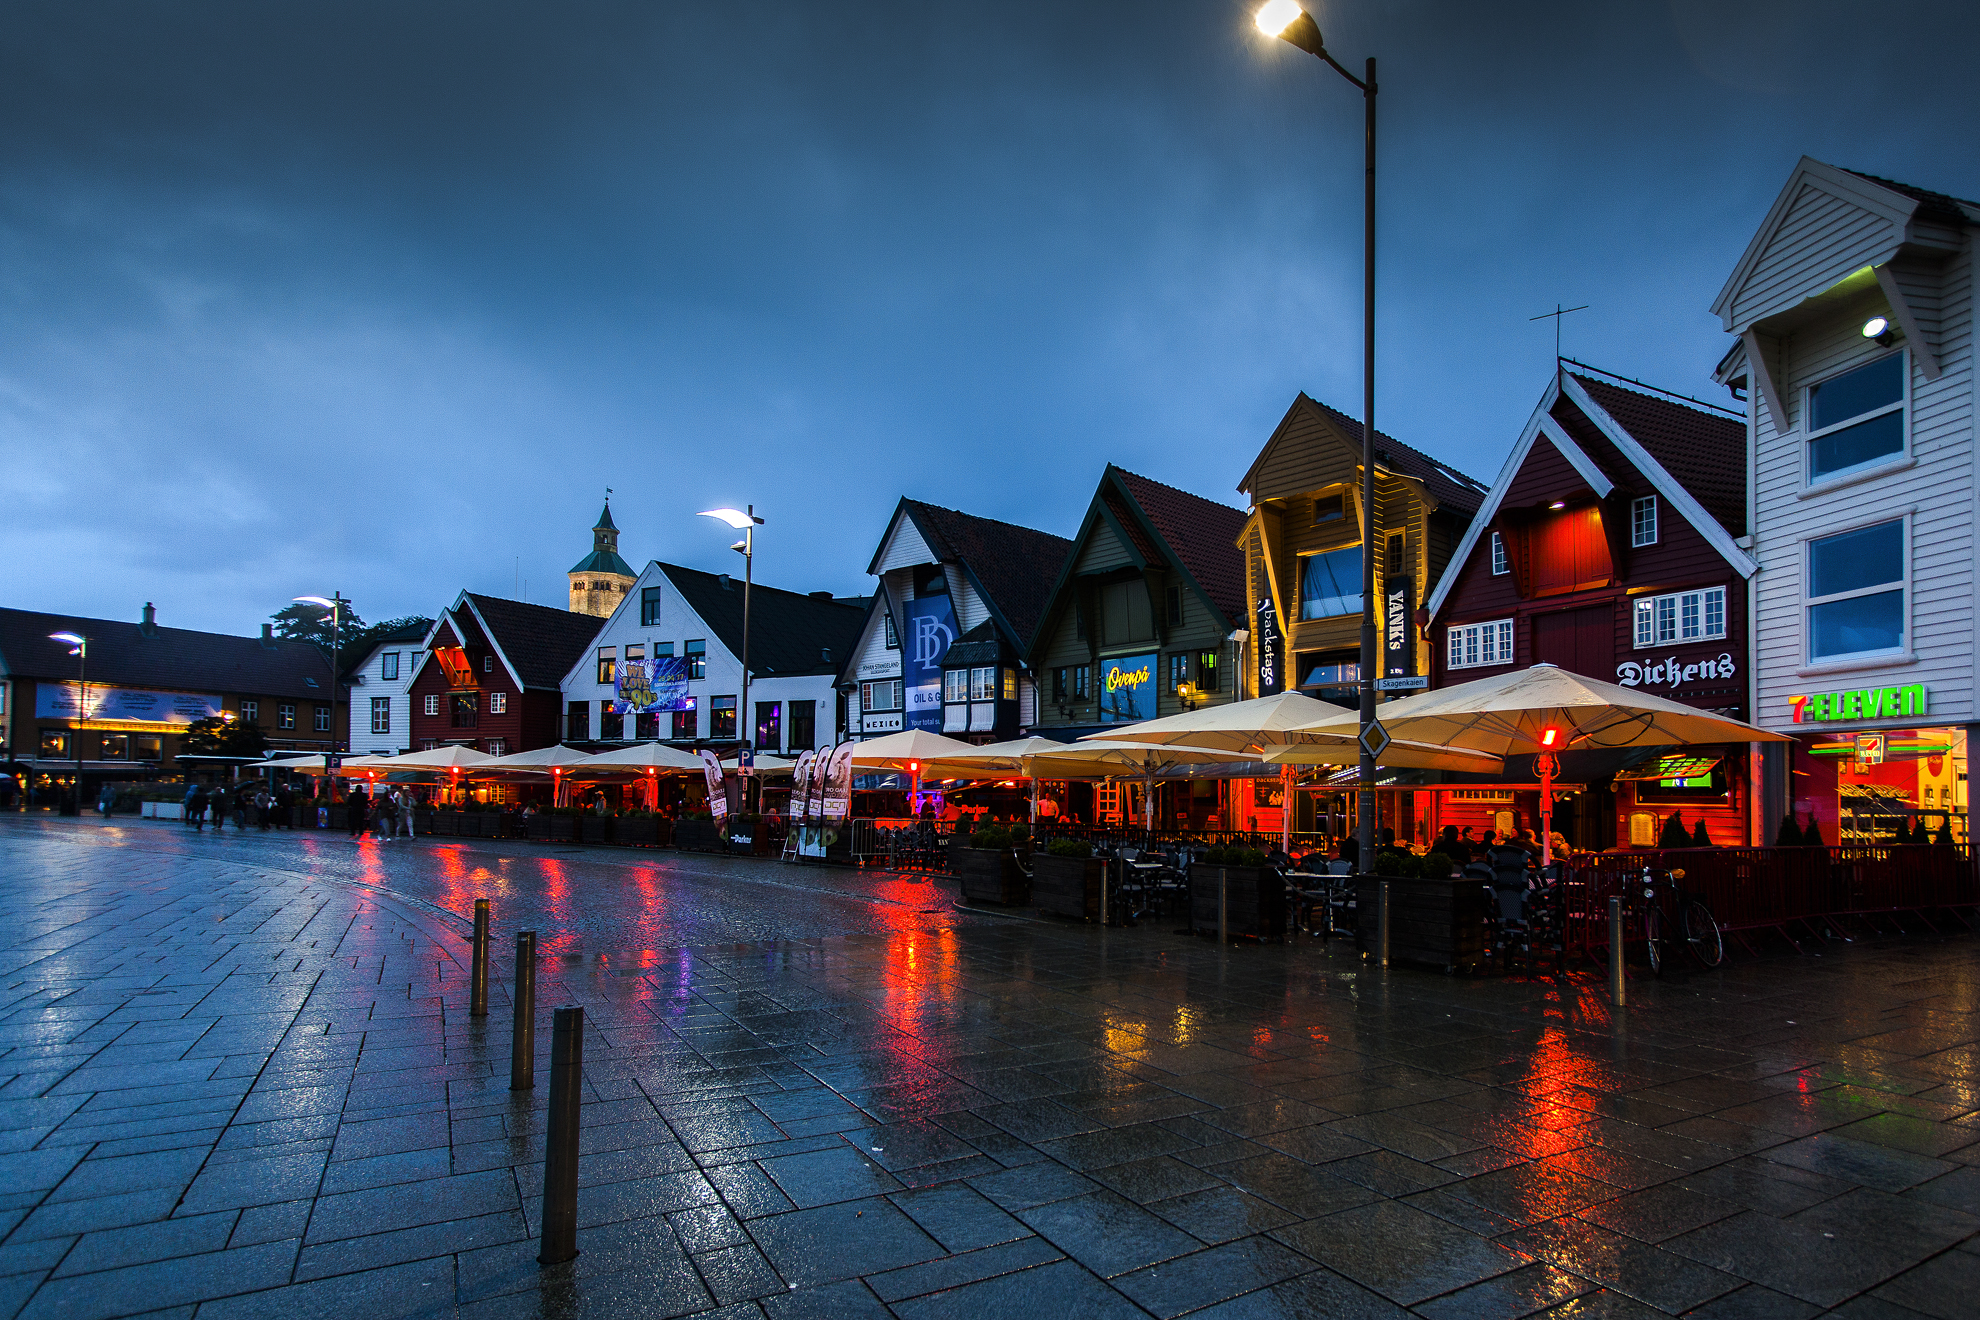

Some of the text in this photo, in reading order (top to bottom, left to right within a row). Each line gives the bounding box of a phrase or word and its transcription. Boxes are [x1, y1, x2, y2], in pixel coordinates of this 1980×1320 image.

[1261, 609, 1278, 686] backstage
[626, 665, 645, 678] WE
[1616, 652, 1735, 689] Dickens
[622, 676, 650, 689] LOVE
[1108, 665, 1150, 691] Ovenpå
[1382, 679, 1424, 688] Skagenkaien
[914, 694, 926, 703] OIL
[928, 692, 934, 702] &
[910, 719, 921, 727] Your
[922, 718, 934, 726] total
[331, 757, 339, 767] P
[742, 751, 750, 765] P
[959, 803, 989, 814] Parker
[730, 833, 752, 844] Parker
